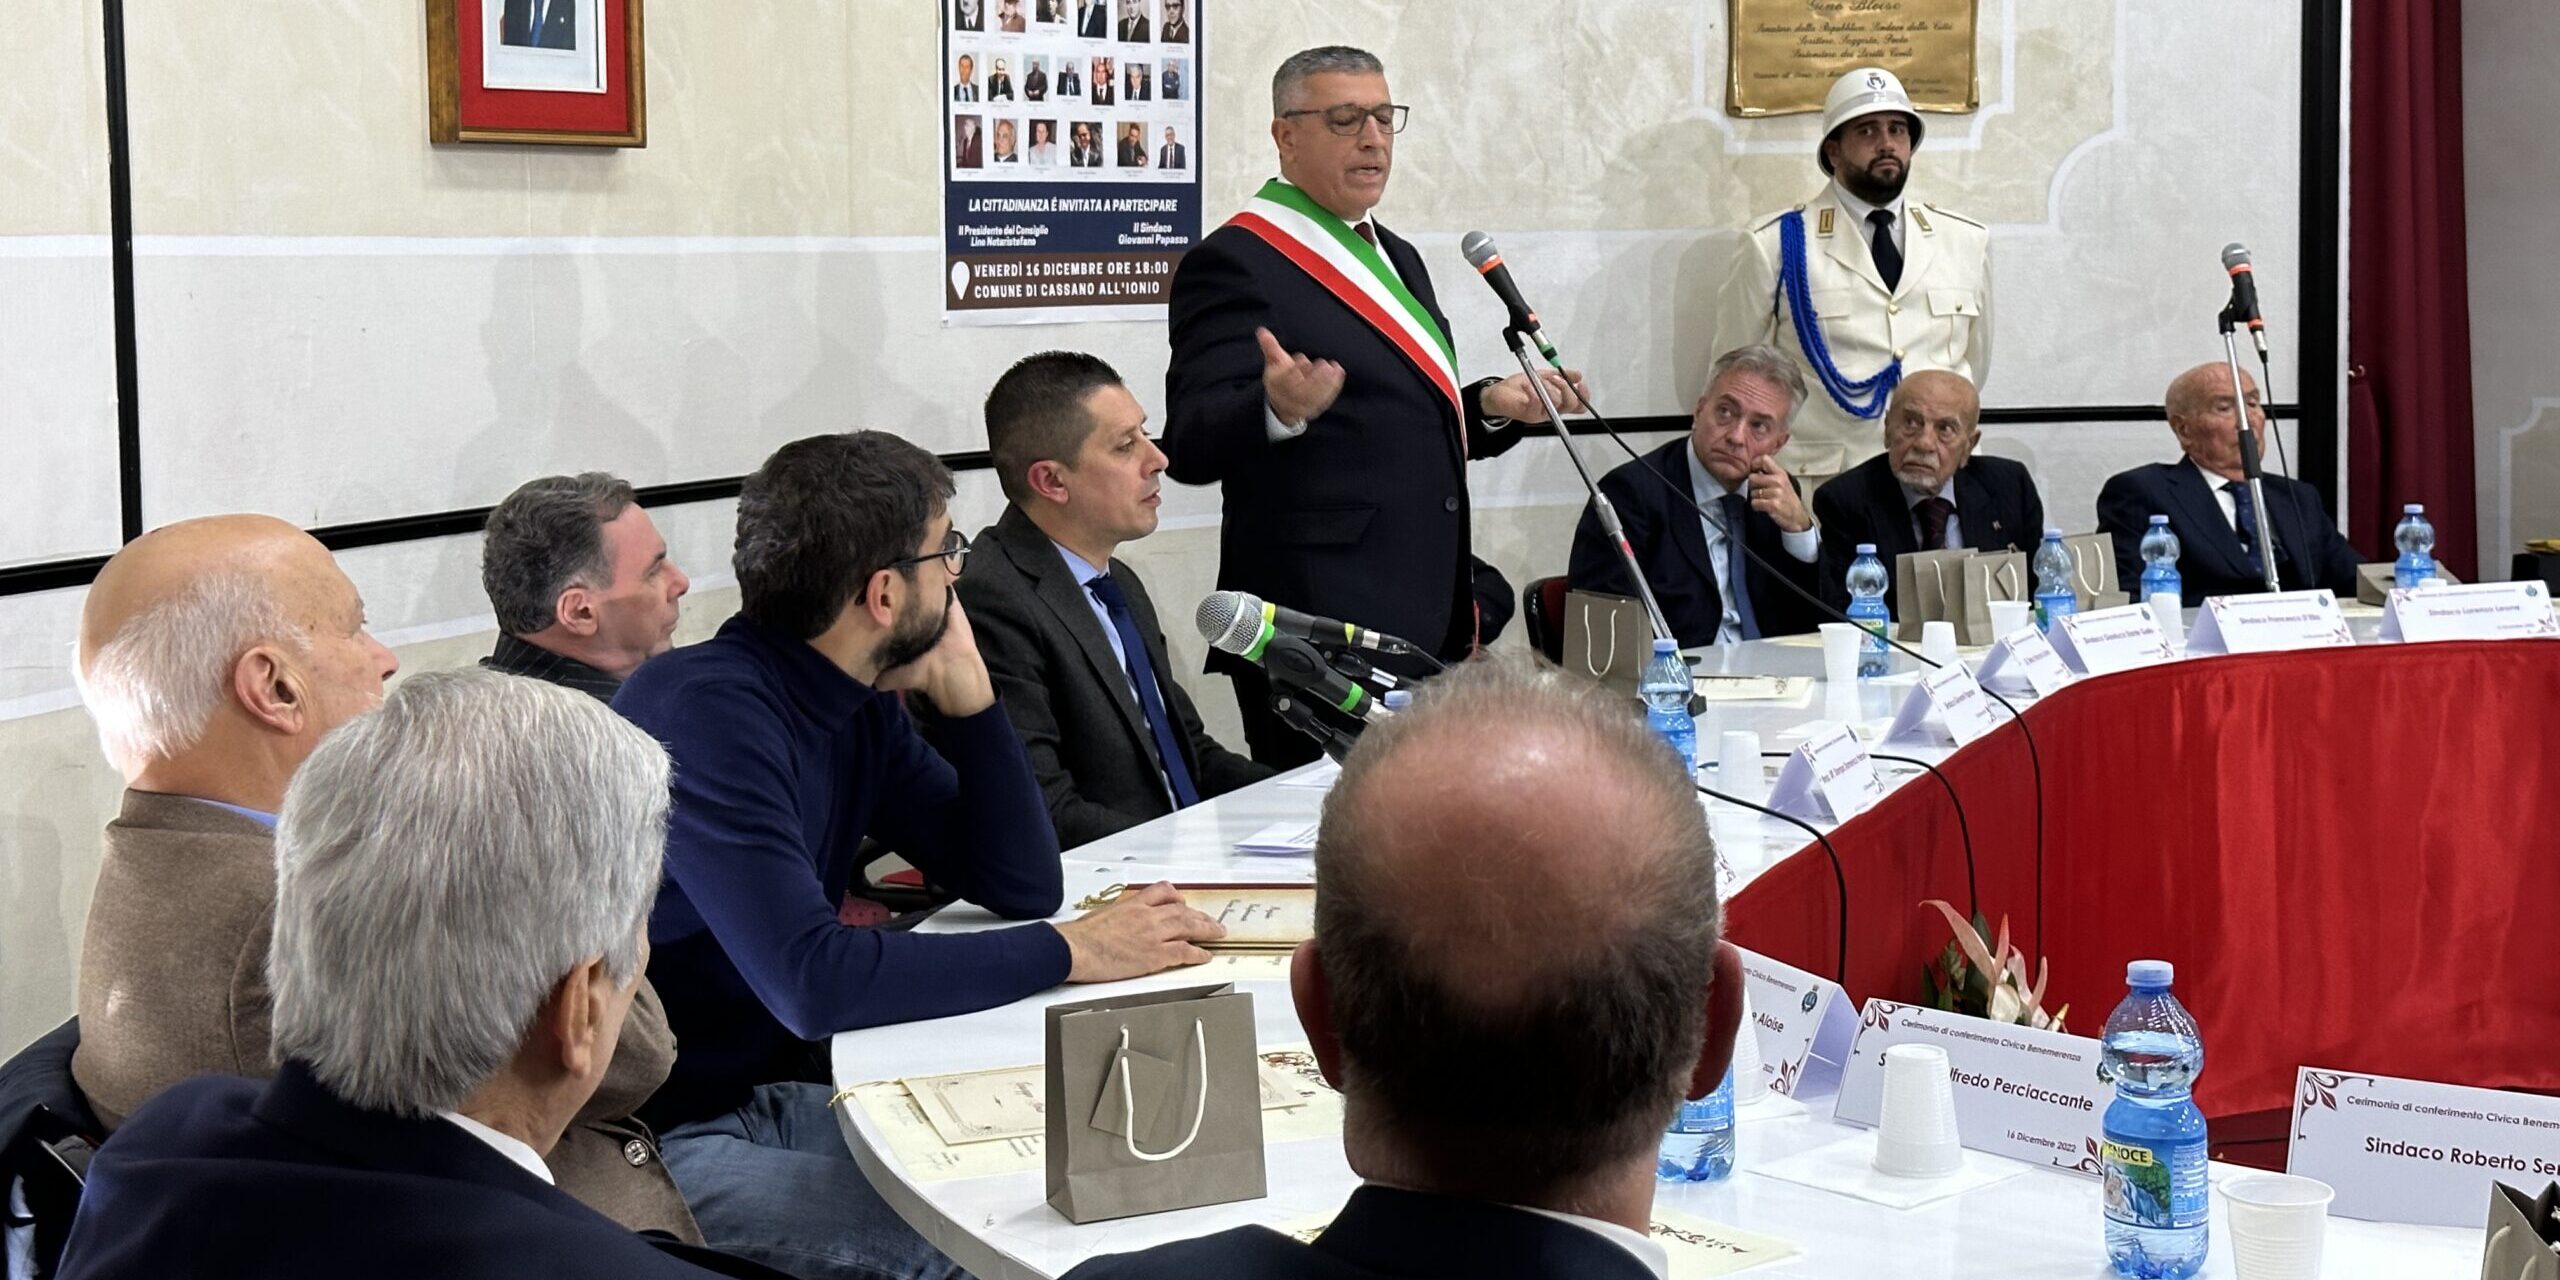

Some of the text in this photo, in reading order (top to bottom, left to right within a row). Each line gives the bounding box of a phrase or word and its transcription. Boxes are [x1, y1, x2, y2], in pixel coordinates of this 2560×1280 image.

[968, 199, 981, 212] LA
[982, 199, 1050, 212] CITTADINANZA
[1059, 199, 1102, 212] INVITATA
[1103, 199, 1112, 211] A
[1112, 199, 1178, 212] PARTECIPARE
[958, 224, 1049, 237] Il Presidente del Consiglio
[1133, 222, 1173, 233] Il Sindaco
[970, 236, 1037, 247] Lino Notaristefano
[1118, 233, 1189, 247] Giovanni Papasso
[974, 261, 1169, 278] VENERDÌ 16 DICEMBRE ORE 18:00
[974, 281, 1160, 299] COMUNE DI CASSANO ALL'IONIO
[1758, 1013, 1785, 1033] Aloise
[1901, 1018, 2082, 1063] Cerimonia di conferimento Civica Benemerenza
[1950, 1067, 2094, 1112] lfredo Perciaccante
[2346, 1095, 2400, 1111] Cerimonia
[2402, 1102, 2413, 1112] di
[2414, 1103, 2484, 1121] conferimento
[2486, 1111, 2520, 1126] Civica
[2006, 1129, 2077, 1154] 16 Dicembre 2022
[2365, 1135, 2445, 1161] Sindaco
[2450, 1147, 2527, 1172] Roberto
